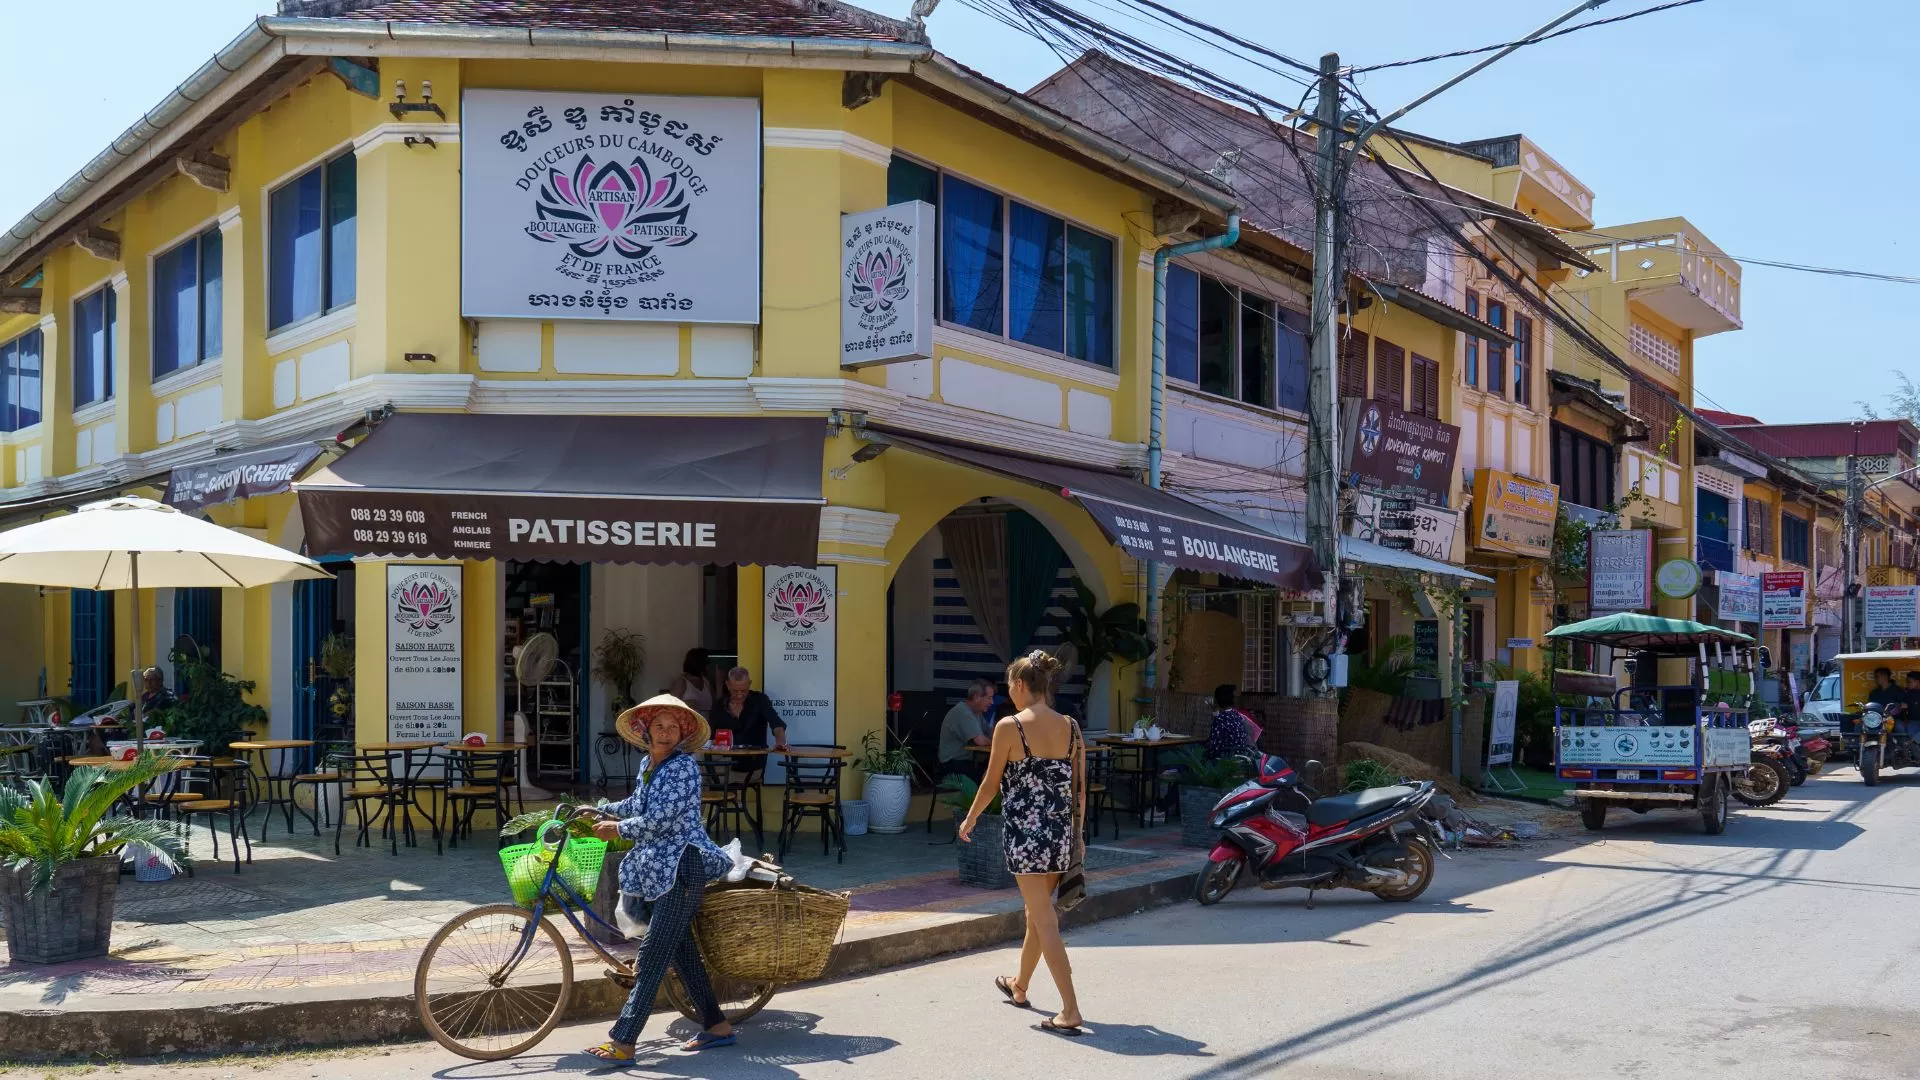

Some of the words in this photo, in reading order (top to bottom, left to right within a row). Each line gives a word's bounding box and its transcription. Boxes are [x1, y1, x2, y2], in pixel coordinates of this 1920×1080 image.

[516, 134, 595, 191] DOUCEURS
[599, 134, 624, 149] DU
[627, 135, 708, 197] CAMBODGE
[588, 191, 635, 203] ARTISAN
[529, 221, 597, 234] BOULANGER
[633, 224, 688, 237] PATISSIER
[845, 239, 873, 278] DOUCEURS
[874, 235, 883, 245] DU
[884, 235, 914, 267] CAMBODGE
[561, 252, 581, 268] ET
[582, 260, 602, 274] DE
[606, 254, 662, 275] FRANCE
[876, 306, 896, 323] FRANCE
[1385, 437, 1421, 457] ADVENTURE
[1421, 448, 1446, 464] KAMPOT
[350, 508, 371, 521] 088
[373, 509, 387, 521] 29
[389, 509, 403, 522] 39
[405, 510, 426, 524] 608
[451, 511, 487, 520] FRENCH
[353, 529, 374, 542] 088
[375, 530, 389, 543] 29
[391, 531, 405, 543] 39
[407, 532, 428, 545] 618
[452, 526, 491, 535] ANGLAIS
[508, 517, 716, 548] PATISSERIE
[454, 540, 491, 549] KHMERE
[1181, 535, 1280, 574] BOULANGERIE
[391, 572, 418, 600] DOUCEURS
[420, 571, 428, 579] DU
[430, 571, 458, 600] CAMBODGE
[767, 572, 794, 599] DOUCEURS
[804, 571, 833, 599] CAMBODGE
[422, 627, 443, 637] FRANCE
[797, 626, 818, 636] FRANCE
[395, 642, 425, 650] SAISON
[427, 642, 455, 650] HAUTE
[785, 641, 814, 649] MENUS
[396, 701, 426, 709] SAISON
[428, 701, 455, 709] BASSE
[787, 699, 829, 707] VEDETTES
[782, 709, 793, 717] DU
[795, 709, 817, 717] JOUR
[421, 730, 431, 738] Le
[432, 730, 455, 738] Lundi
